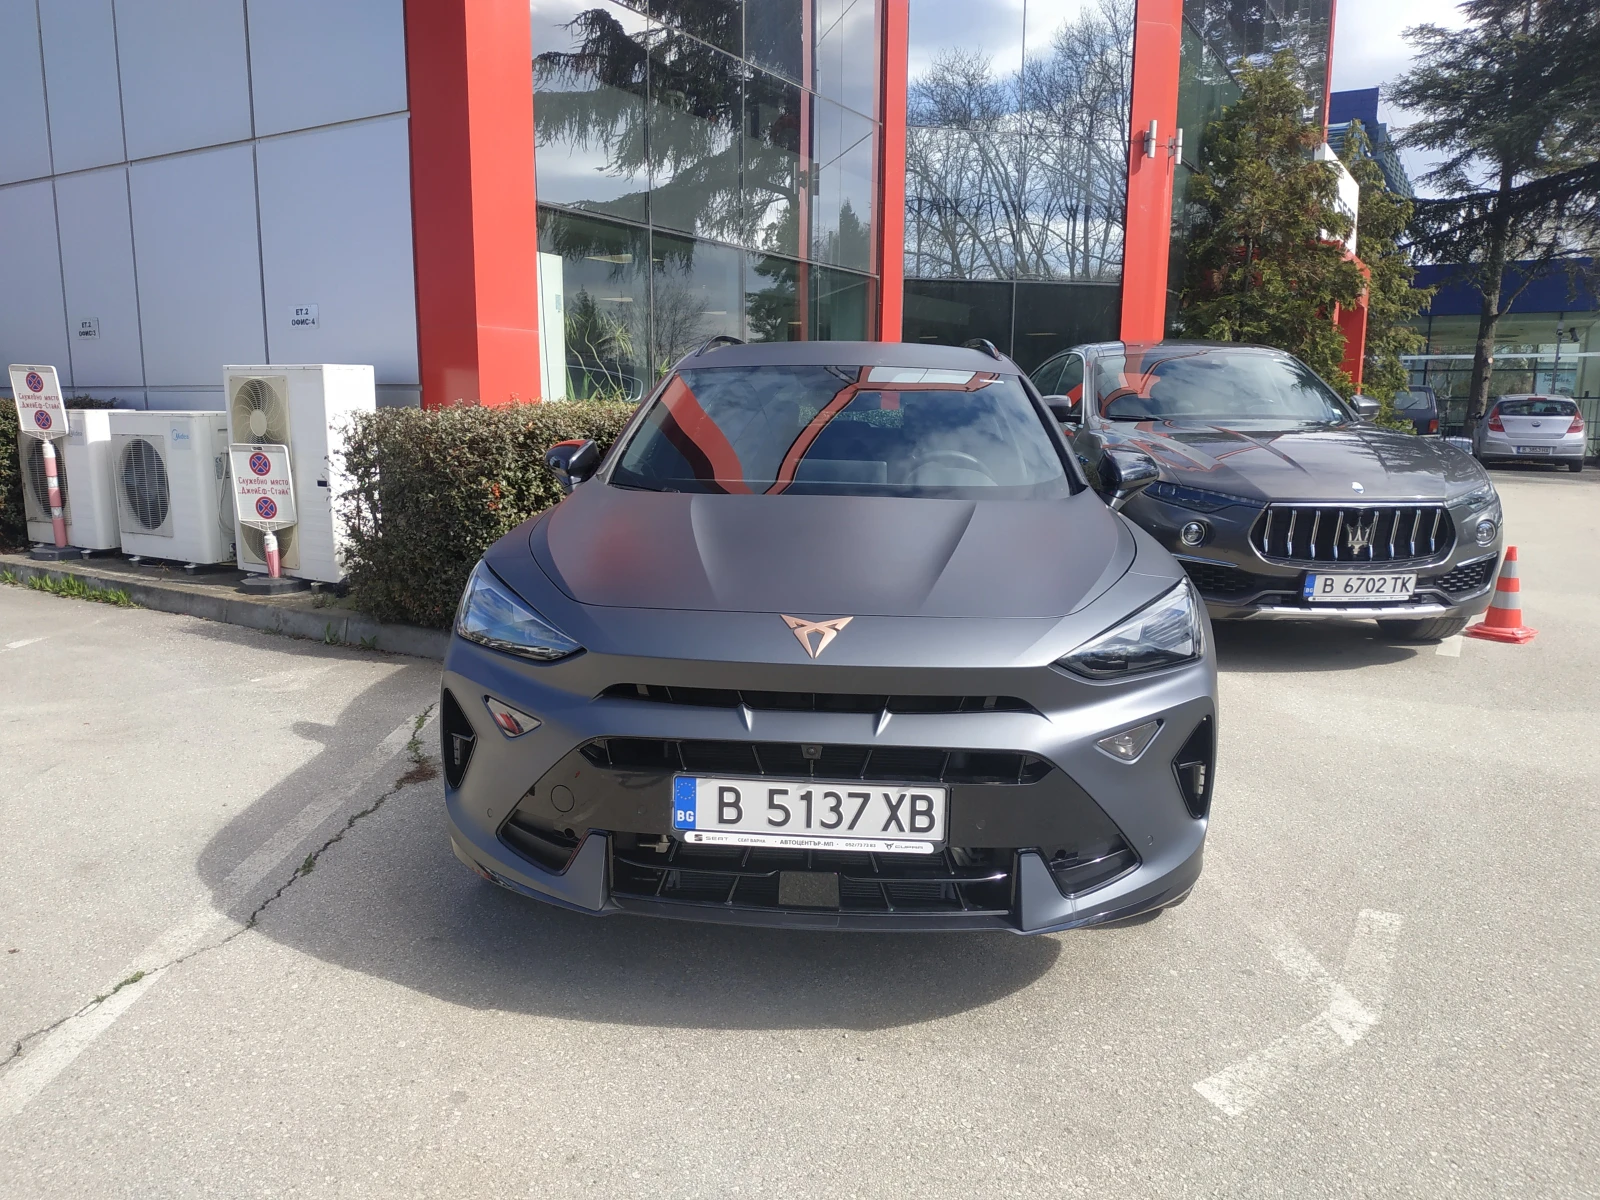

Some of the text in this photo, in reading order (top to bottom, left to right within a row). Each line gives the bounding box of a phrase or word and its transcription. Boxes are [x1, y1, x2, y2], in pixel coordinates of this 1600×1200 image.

[18, 393, 42, 401] Служебно
[238, 477, 268, 486] Служебно
[1322, 576, 1413, 594] B 6702 TK
[717, 785, 936, 833] B 5137 XB
[676, 810, 695, 822] BG
[779, 839, 834, 847] АВТОЦЕНТЪР-МП
